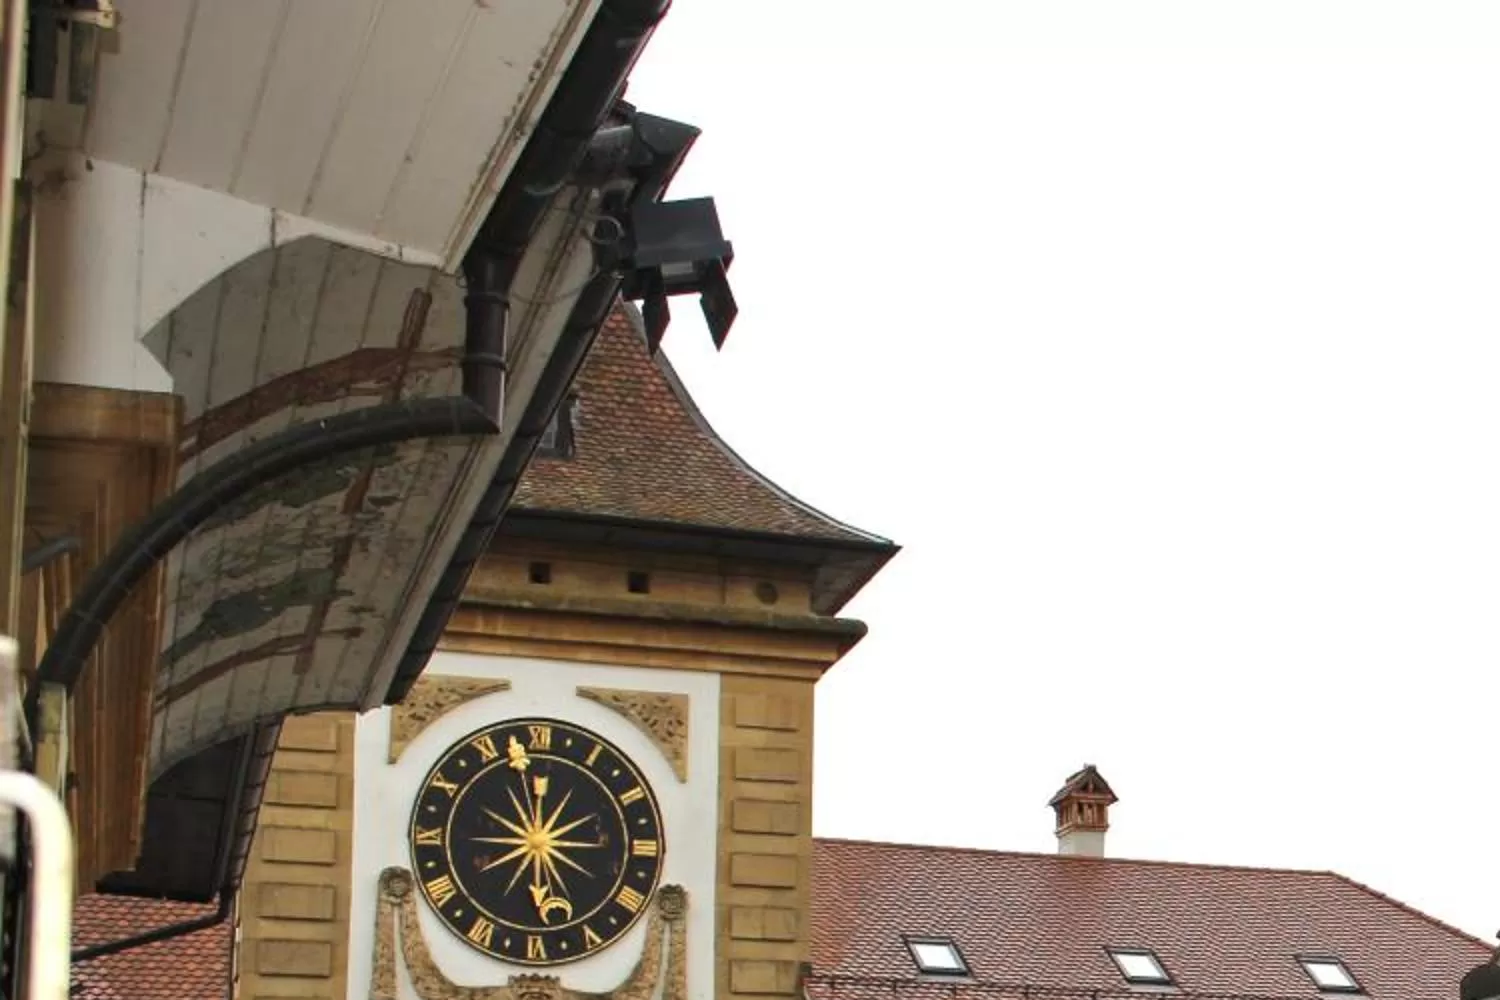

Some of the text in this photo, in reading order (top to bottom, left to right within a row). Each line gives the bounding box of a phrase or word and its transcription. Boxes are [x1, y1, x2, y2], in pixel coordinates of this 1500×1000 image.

[528, 725, 552, 749] XII
[432, 770, 459, 798] X
[620, 786, 645, 806] II
[632, 839, 657, 857] III
